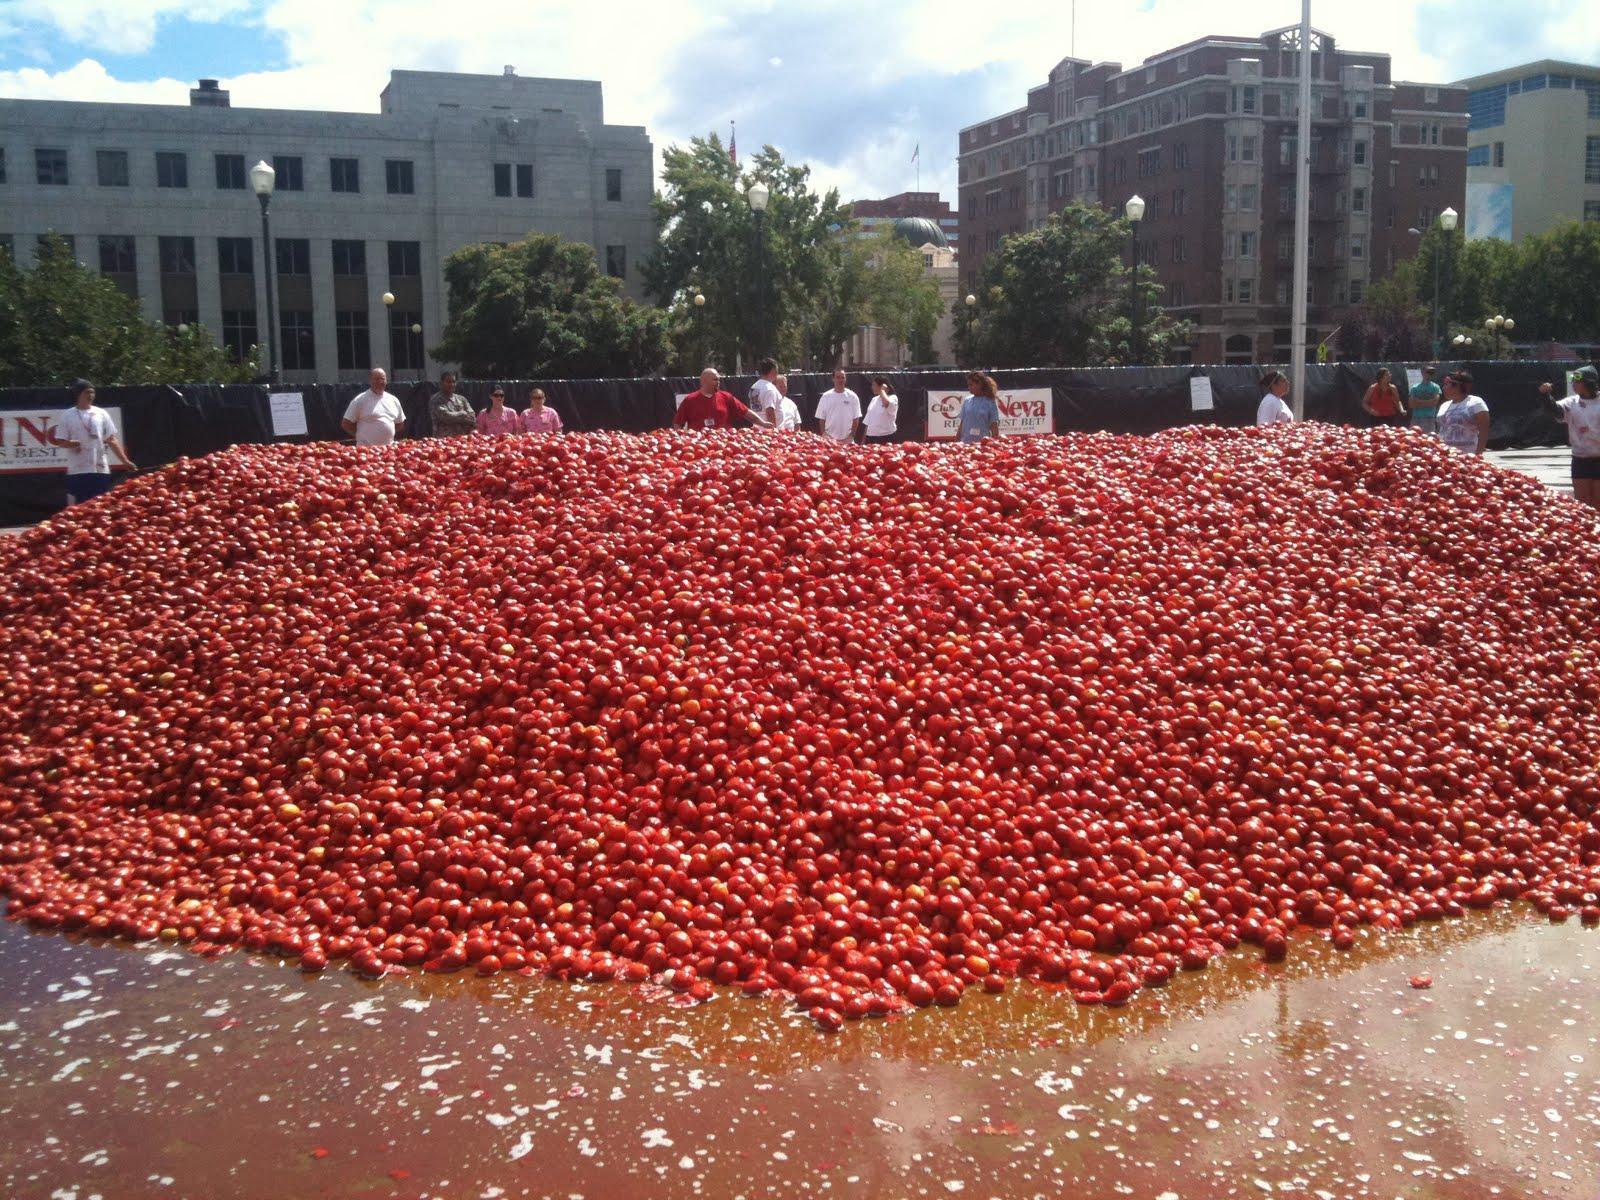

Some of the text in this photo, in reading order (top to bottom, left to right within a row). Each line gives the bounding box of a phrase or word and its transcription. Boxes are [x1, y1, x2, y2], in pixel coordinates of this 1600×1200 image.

[931, 403, 955, 413] Club
[996, 395, 1046, 417] Neva
[1021, 418, 1045, 427] BET!
[15, 447, 57, 458] BEST
